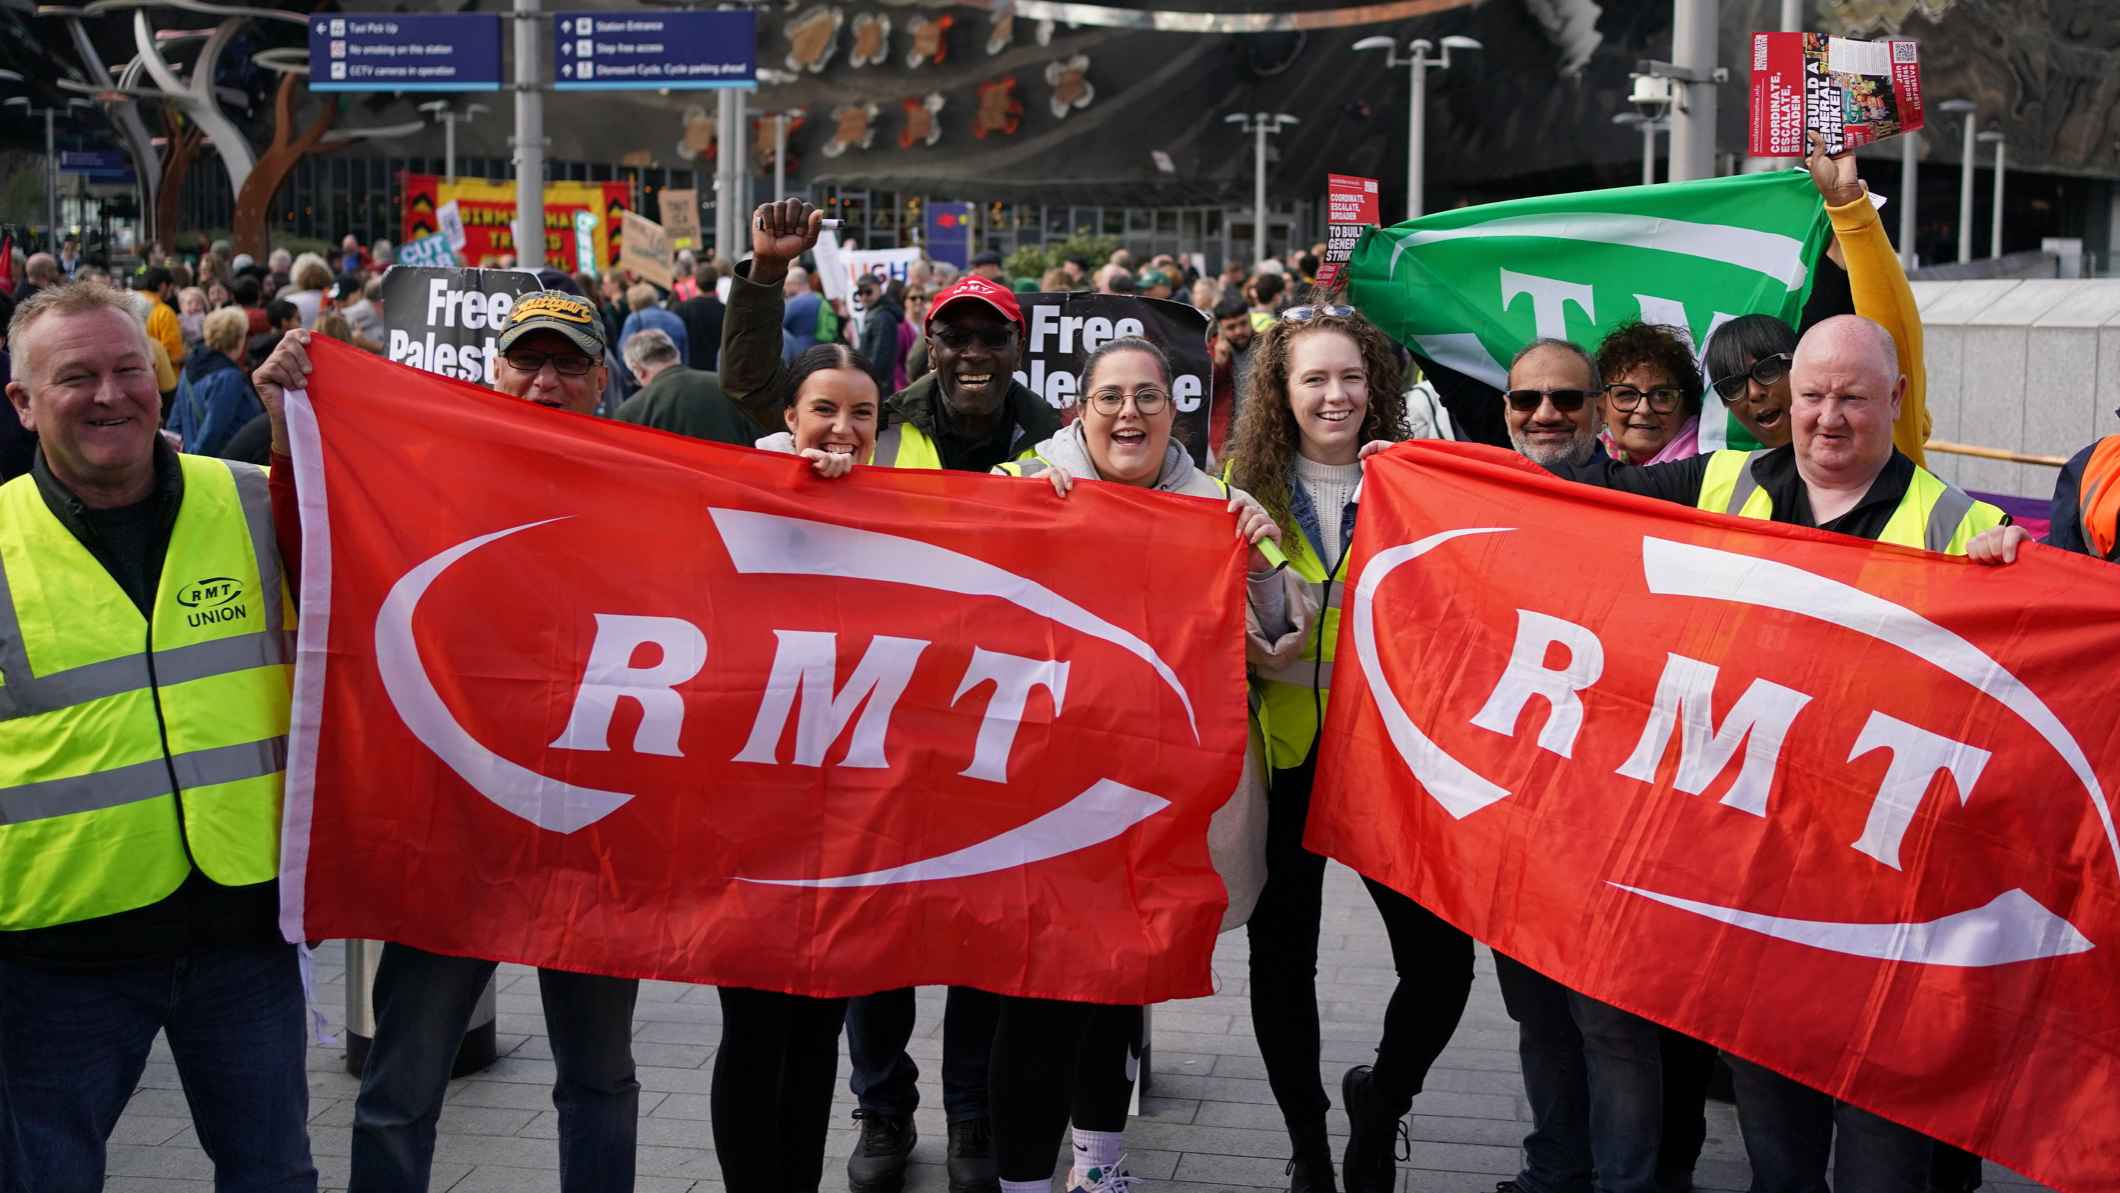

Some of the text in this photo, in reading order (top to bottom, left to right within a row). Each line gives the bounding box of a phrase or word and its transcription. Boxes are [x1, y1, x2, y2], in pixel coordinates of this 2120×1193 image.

[367, 22, 384, 34] Pick
[385, 22, 399, 35] Up
[596, 20, 664, 32] Station Entrance
[349, 44, 453, 57] No smoking on this station
[596, 42, 664, 55] Step free access
[349, 64, 456, 77] CCTV cameras in operation
[596, 64, 636, 76] Dismount
[663, 63, 687, 77] Cycle
[688, 63, 720, 76] parking
[720, 63, 747, 74] ahead
[1807, 61, 1819, 74] A
[1895, 65, 1903, 83] Join
[1902, 65, 1912, 102] Socialist
[1909, 64, 1921, 110] Alternative
[1807, 77, 1819, 128] BUILD
[1753, 85, 1761, 152] socialistalternative.info
[1770, 72, 1782, 154] COORDINATE,
[1781, 85, 1792, 153] ESCALATE,
[1791, 95, 1801, 153] BROADEN
[1830, 89, 1845, 155] STRIKE!
[1331, 193, 1365, 203] COORDINATE,
[1331, 203, 1361, 212] ESCALATE,
[1331, 212, 1357, 220] BROADEN
[1329, 225, 1341, 238] TO
[401, 235, 443, 262] CUT
[1328, 238, 1359, 250] GENER
[1326, 250, 1353, 262] STRIK
[959, 284, 989, 292] RMT
[427, 278, 514, 329] Free
[388, 329, 498, 385] Palest
[192, 584, 230, 601] RMT
[188, 604, 246, 627] UNION
[548, 613, 1071, 784] RMT
[1469, 608, 1992, 872] RMT
